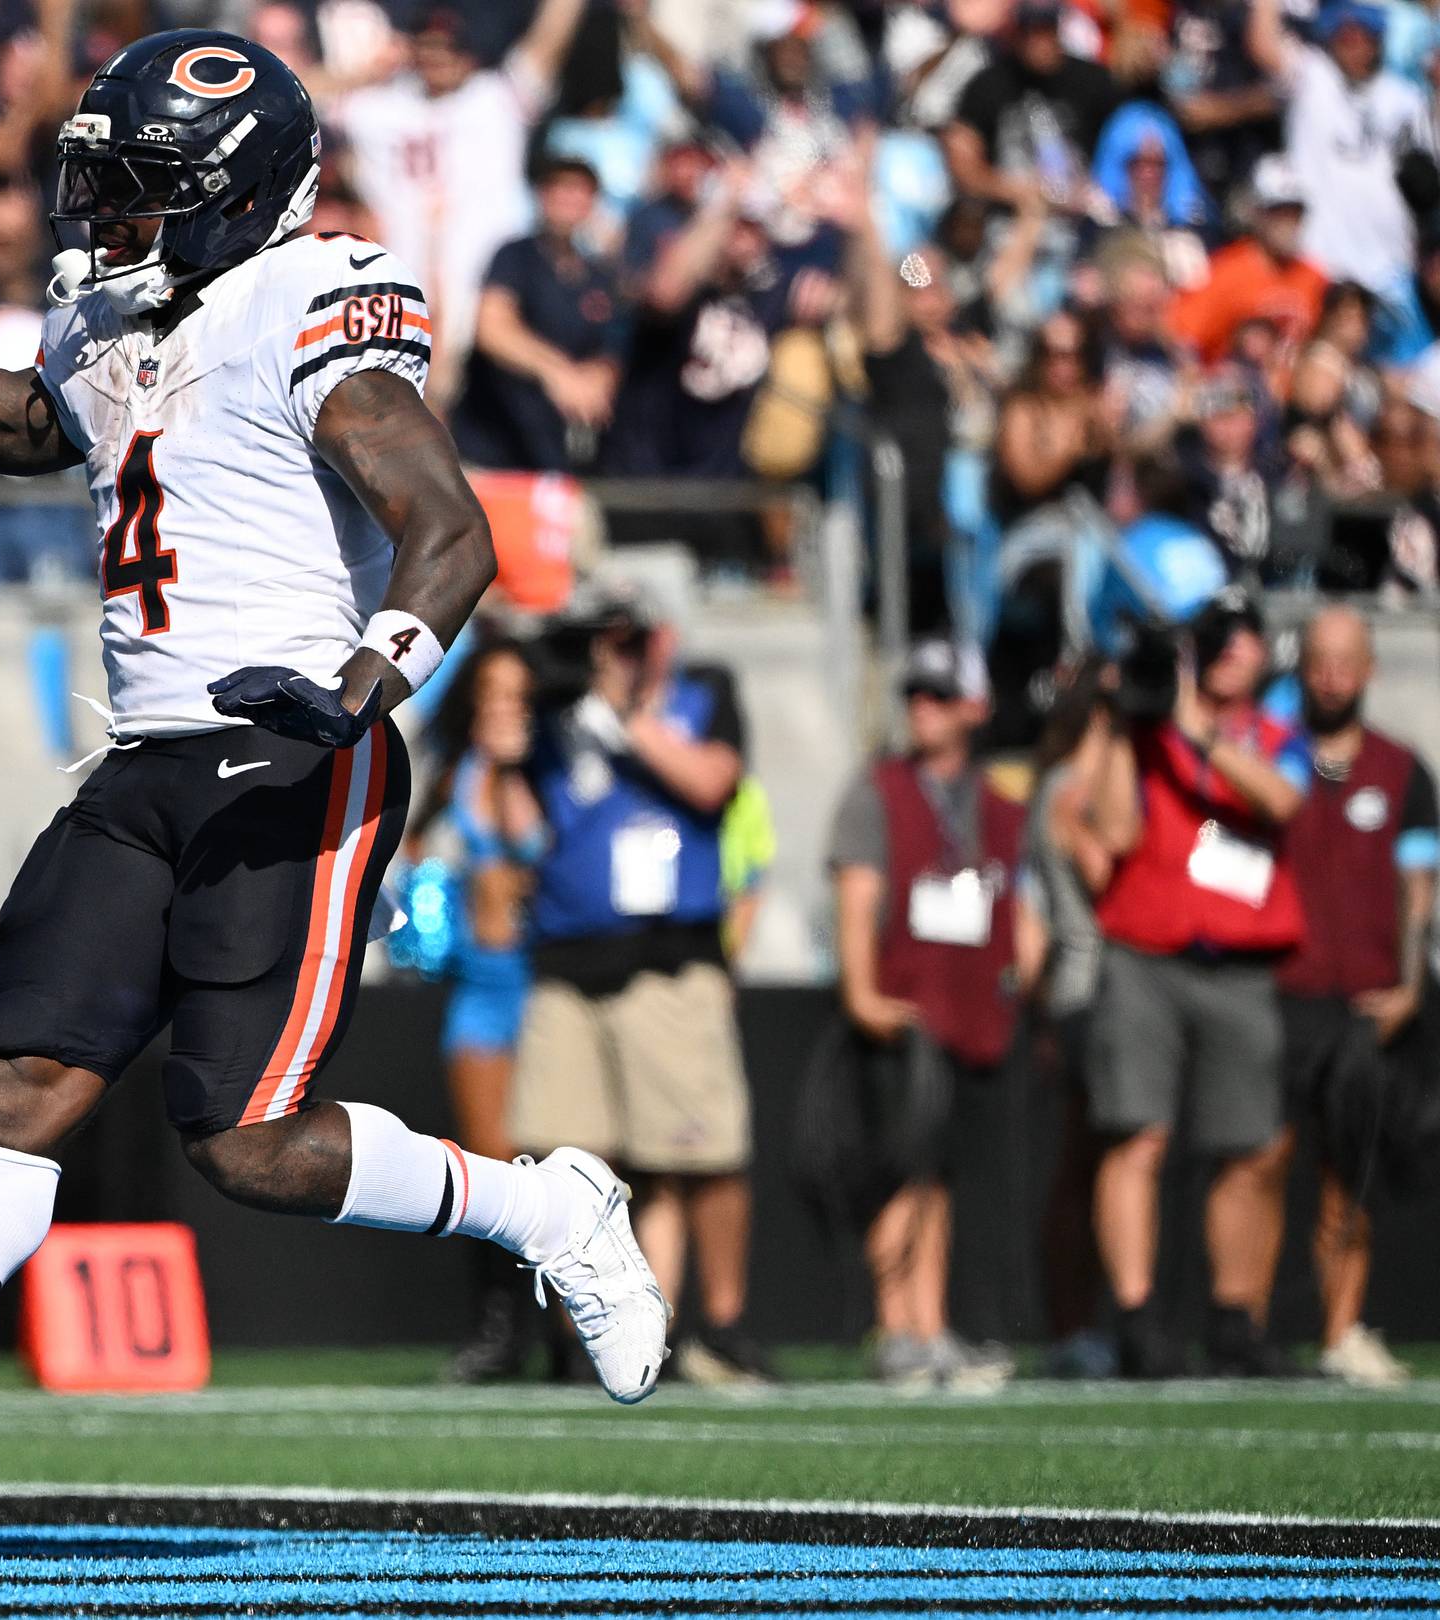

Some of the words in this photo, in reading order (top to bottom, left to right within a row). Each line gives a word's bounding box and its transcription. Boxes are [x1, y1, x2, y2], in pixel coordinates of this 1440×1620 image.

[167, 47, 256, 98] C
[137, 134, 174, 143] OAKLEY
[342, 293, 404, 344] GSH
[139, 370, 157, 383] NFL
[101, 427, 178, 637] 4
[388, 627, 422, 663] 4
[74, 1255, 173, 1360] 10
